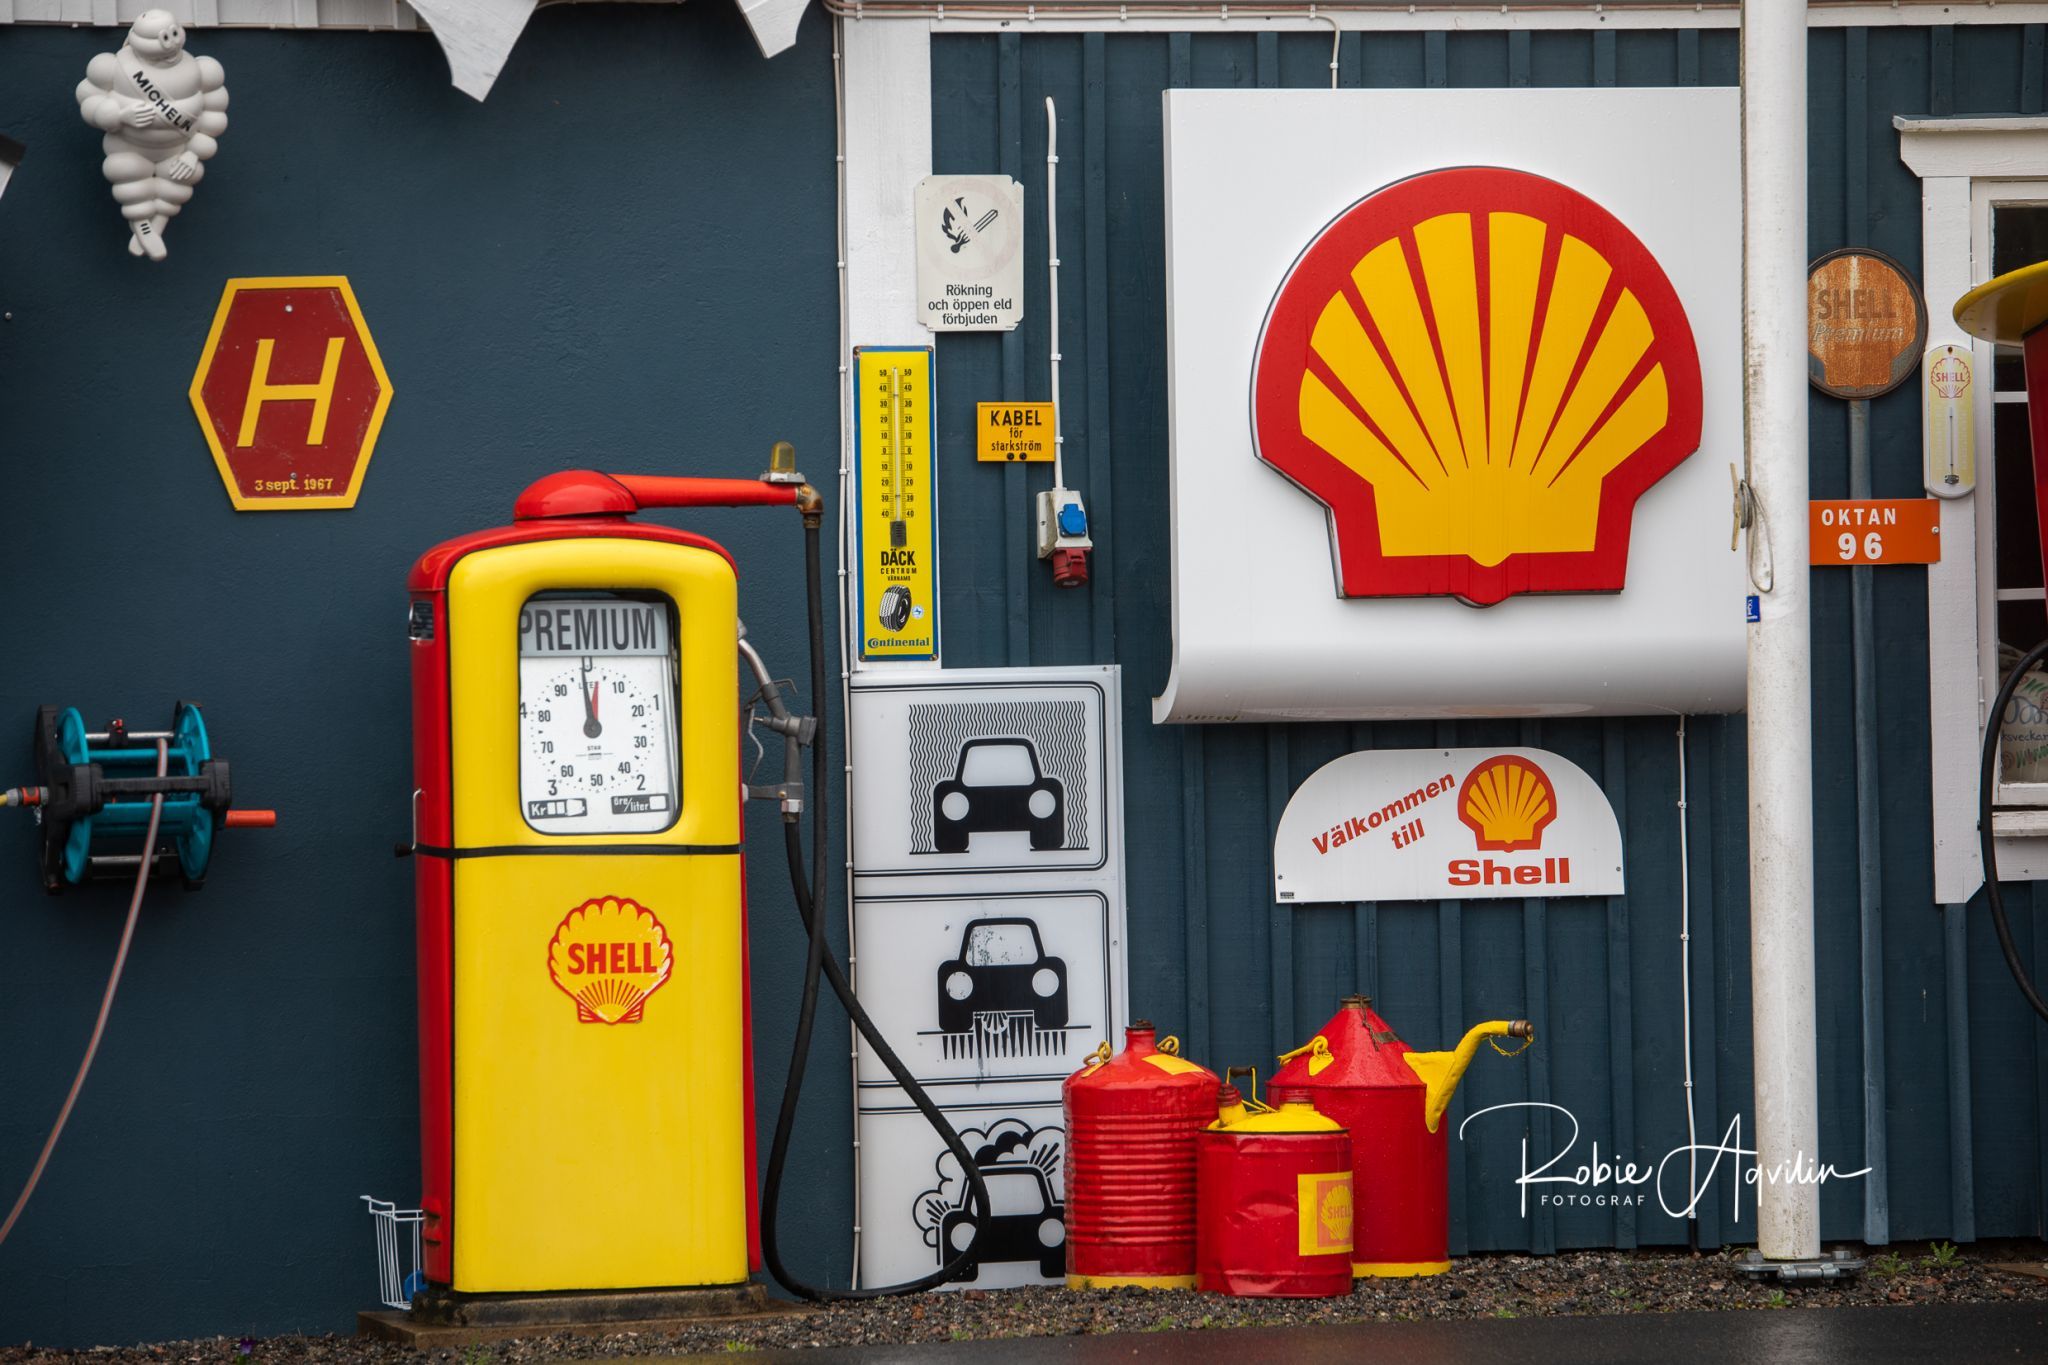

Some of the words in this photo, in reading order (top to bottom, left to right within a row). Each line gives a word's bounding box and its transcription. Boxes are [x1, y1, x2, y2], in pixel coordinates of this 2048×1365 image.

[946, 284, 993, 298] Rökning
[928, 299, 949, 311] och
[952, 299, 990, 312] öppen
[993, 298, 1012, 310] eld
[1817, 288, 1898, 320] SHELL
[942, 313, 998, 326] förbjuden
[1812, 320, 1905, 342] Premium
[1936, 372, 1965, 383] SHELL
[236, 337, 345, 447] H
[990, 410, 1041, 426] KABEL
[1009, 427, 1023, 439] för
[991, 439, 1042, 452] starkström
[254, 479, 264, 491] 3
[266, 478, 299, 494] sept.
[303, 478, 334, 491] 1967
[1821, 508, 1897, 526] OKTAN
[1837, 532, 1883, 560] 96
[881, 548, 916, 566] DÄCK
[880, 567, 917, 575] CENTRUM
[520, 608, 657, 651] PREMIUM
[867, 637, 930, 649] Continental
[554, 684, 567, 696] 90
[612, 681, 625, 693] 10
[653, 694, 660, 711] 1
[538, 710, 551, 722] 80
[631, 705, 644, 717] 20
[541, 741, 553, 753] 70
[634, 736, 647, 748] 30
[561, 765, 574, 777] 60
[618, 762, 631, 774] 40
[590, 774, 603, 786] 50
[636, 774, 646, 791] 2
[548, 780, 558, 796] 3
[531, 803, 547, 817] Kr
[1311, 772, 1456, 856] Välkommen
[1391, 818, 1426, 851] till
[1447, 857, 1570, 887] Shell
[567, 942, 658, 975] SHELL
[1327, 1205, 1352, 1219] SHELL
